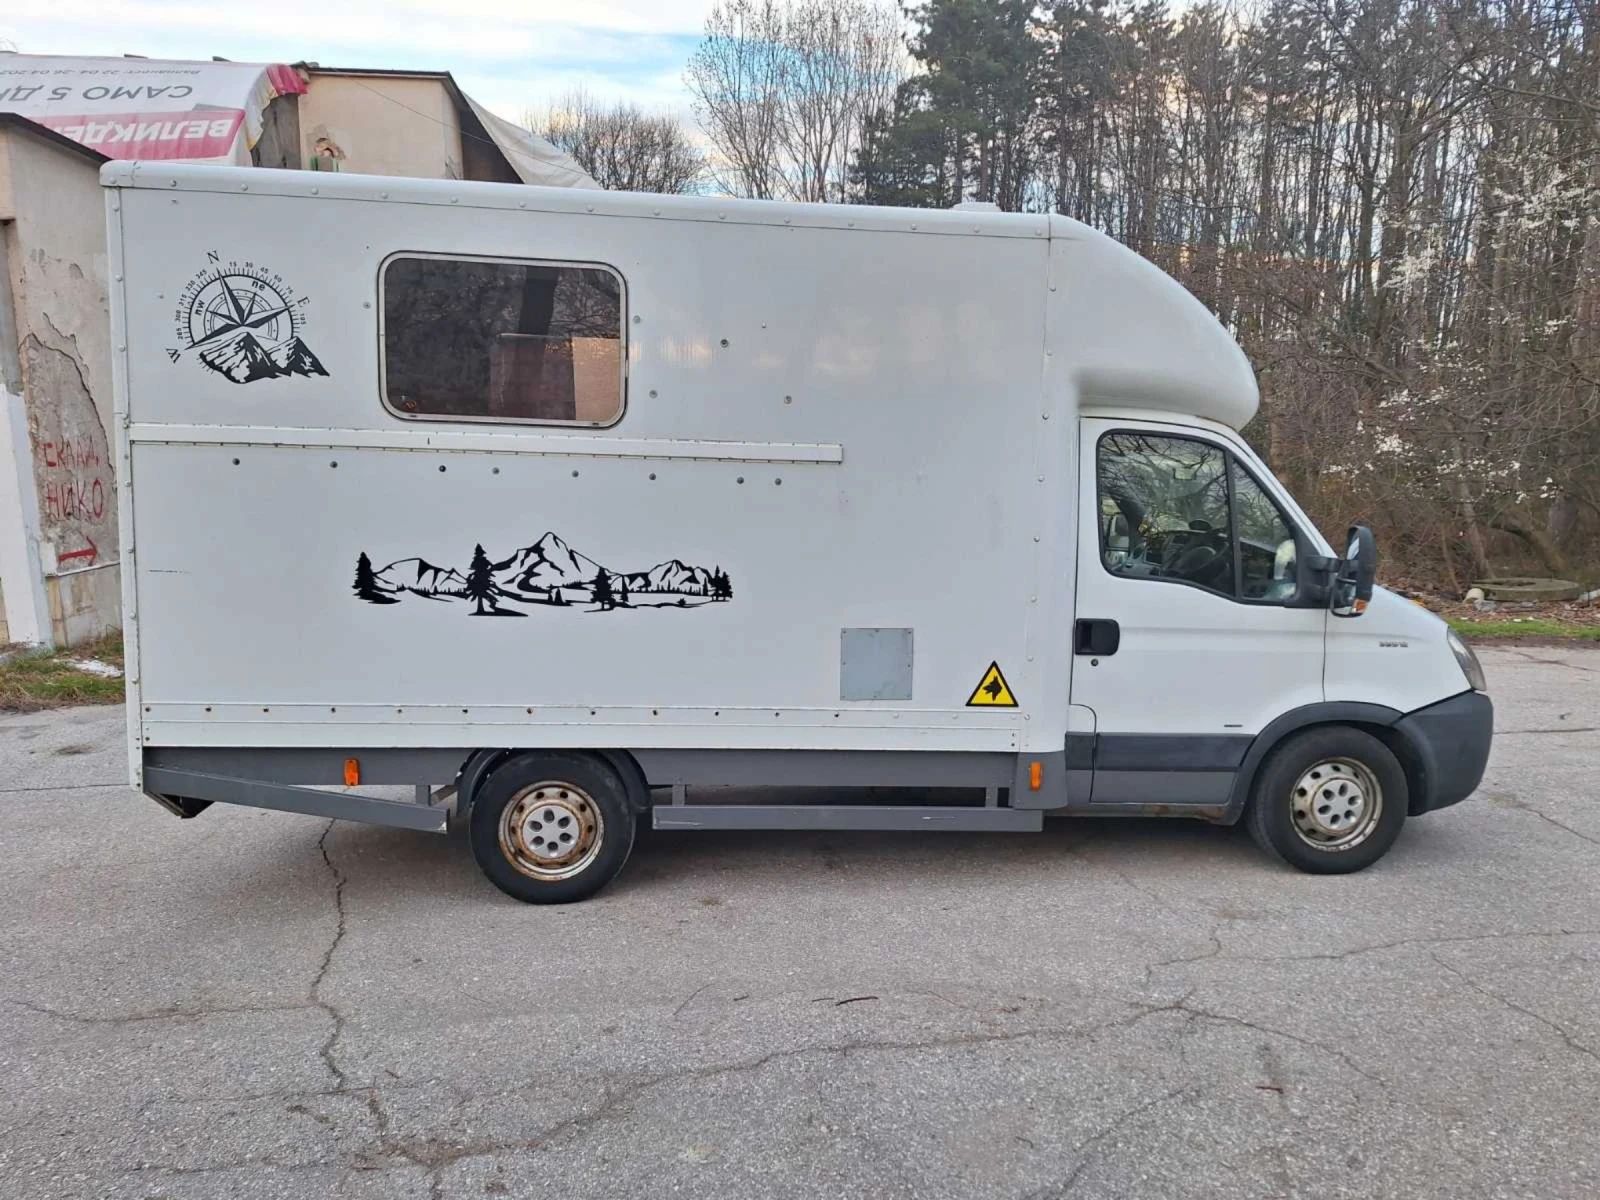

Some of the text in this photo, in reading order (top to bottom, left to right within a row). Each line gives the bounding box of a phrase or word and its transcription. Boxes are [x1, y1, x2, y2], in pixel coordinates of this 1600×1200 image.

[46, 86, 73, 101] 5
[82, 85, 194, 101] САМО
[53, 118, 234, 145] ВЕЛИКДЕ
[206, 250, 220, 264] N
[297, 296, 311, 308] E
[165, 348, 182, 364] W
